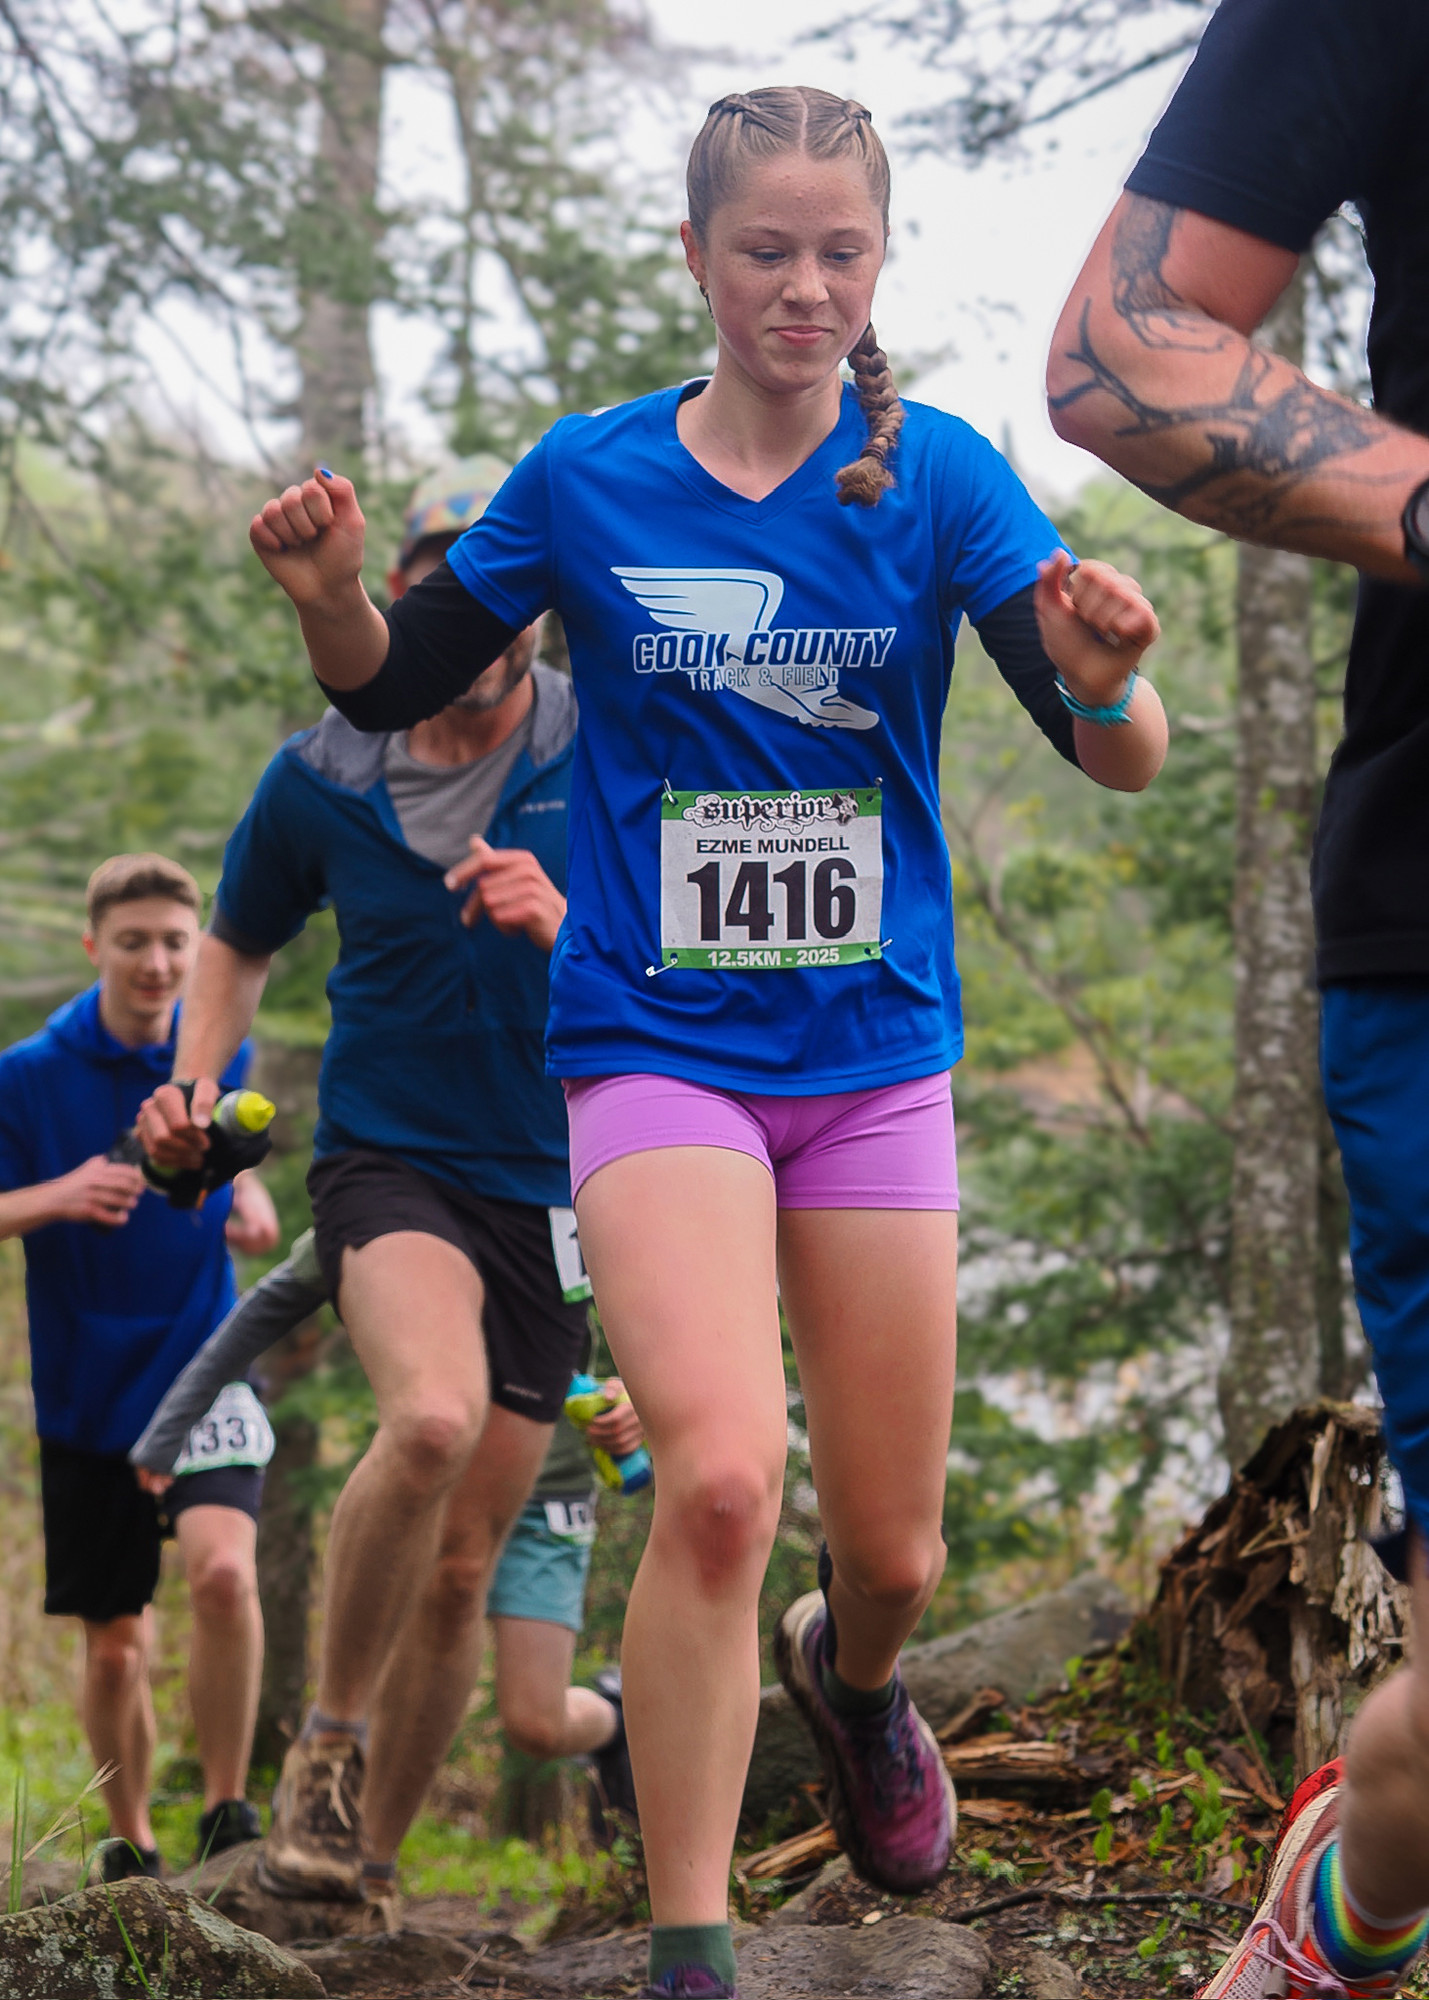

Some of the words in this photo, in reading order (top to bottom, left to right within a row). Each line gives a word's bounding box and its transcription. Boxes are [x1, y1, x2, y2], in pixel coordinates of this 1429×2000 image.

[633, 631, 739, 674] COOK
[743, 627, 897, 668] COUNTY
[687, 667, 751, 691] TRACK
[758, 668, 775, 687] &
[783, 667, 839, 687] FIELD
[696, 839, 752, 854] EZME
[758, 836, 850, 853] MUNDELL
[687, 857, 857, 941] 1416
[708, 951, 781, 967] 12.5KM
[796, 948, 840, 966] 2025
